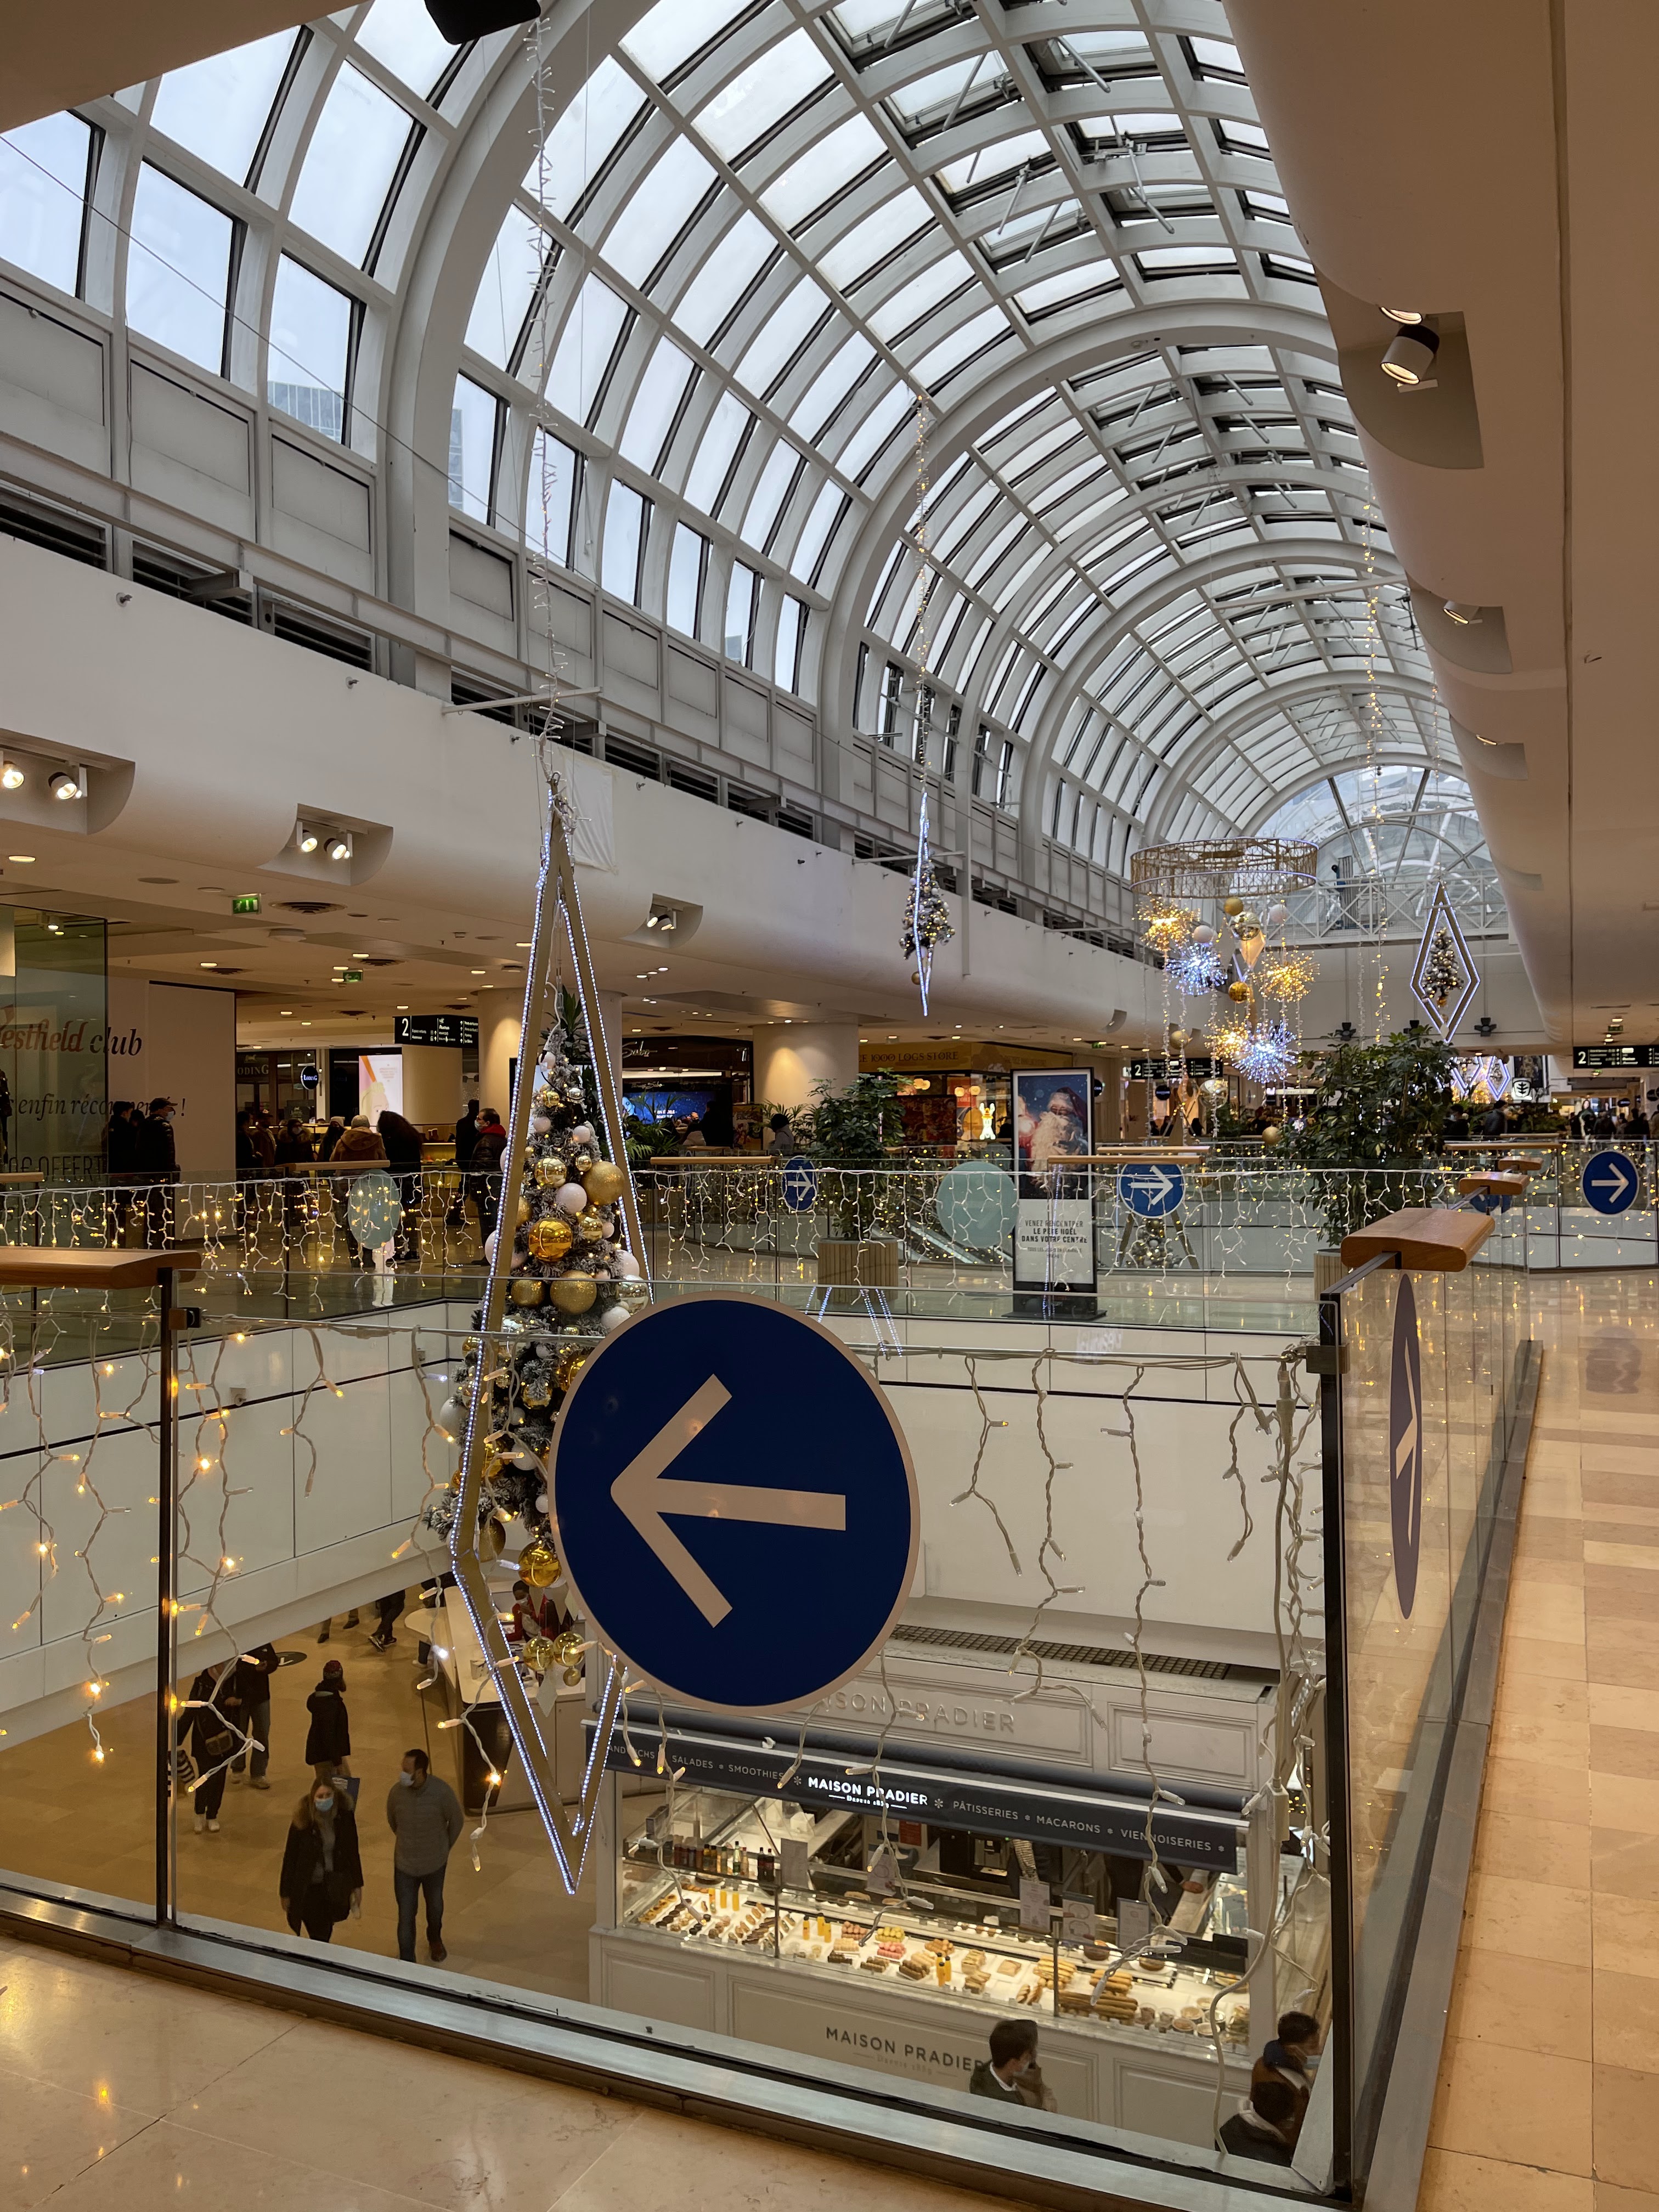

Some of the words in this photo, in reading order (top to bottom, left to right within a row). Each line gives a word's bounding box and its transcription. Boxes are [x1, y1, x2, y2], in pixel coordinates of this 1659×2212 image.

[402, 1018, 409, 1037] 2
[89, 1026, 143, 1056] club
[898, 1052, 924, 1061] LOGS
[927, 1051, 959, 1061] STORE
[1578, 1051, 1587, 1064] 2
[237, 1064, 269, 1075] ODING
[1135, 1064, 1142, 1076] 2
[18, 1093, 66, 1121] enfin
[672, 1755, 714, 1769] SALADES
[727, 1764, 785, 1780] SMOOTHIES
[808, 1776, 862, 1796] MAISON
[867, 1785, 928, 1805] PRADIER
[952, 1800, 1019, 1820] PÂTISSERIES
[1036, 1815, 1101, 1834] MACARONS
[1120, 1828, 1212, 1852] VIENNOISERIES
[826, 2027, 896, 2055] MAISON
